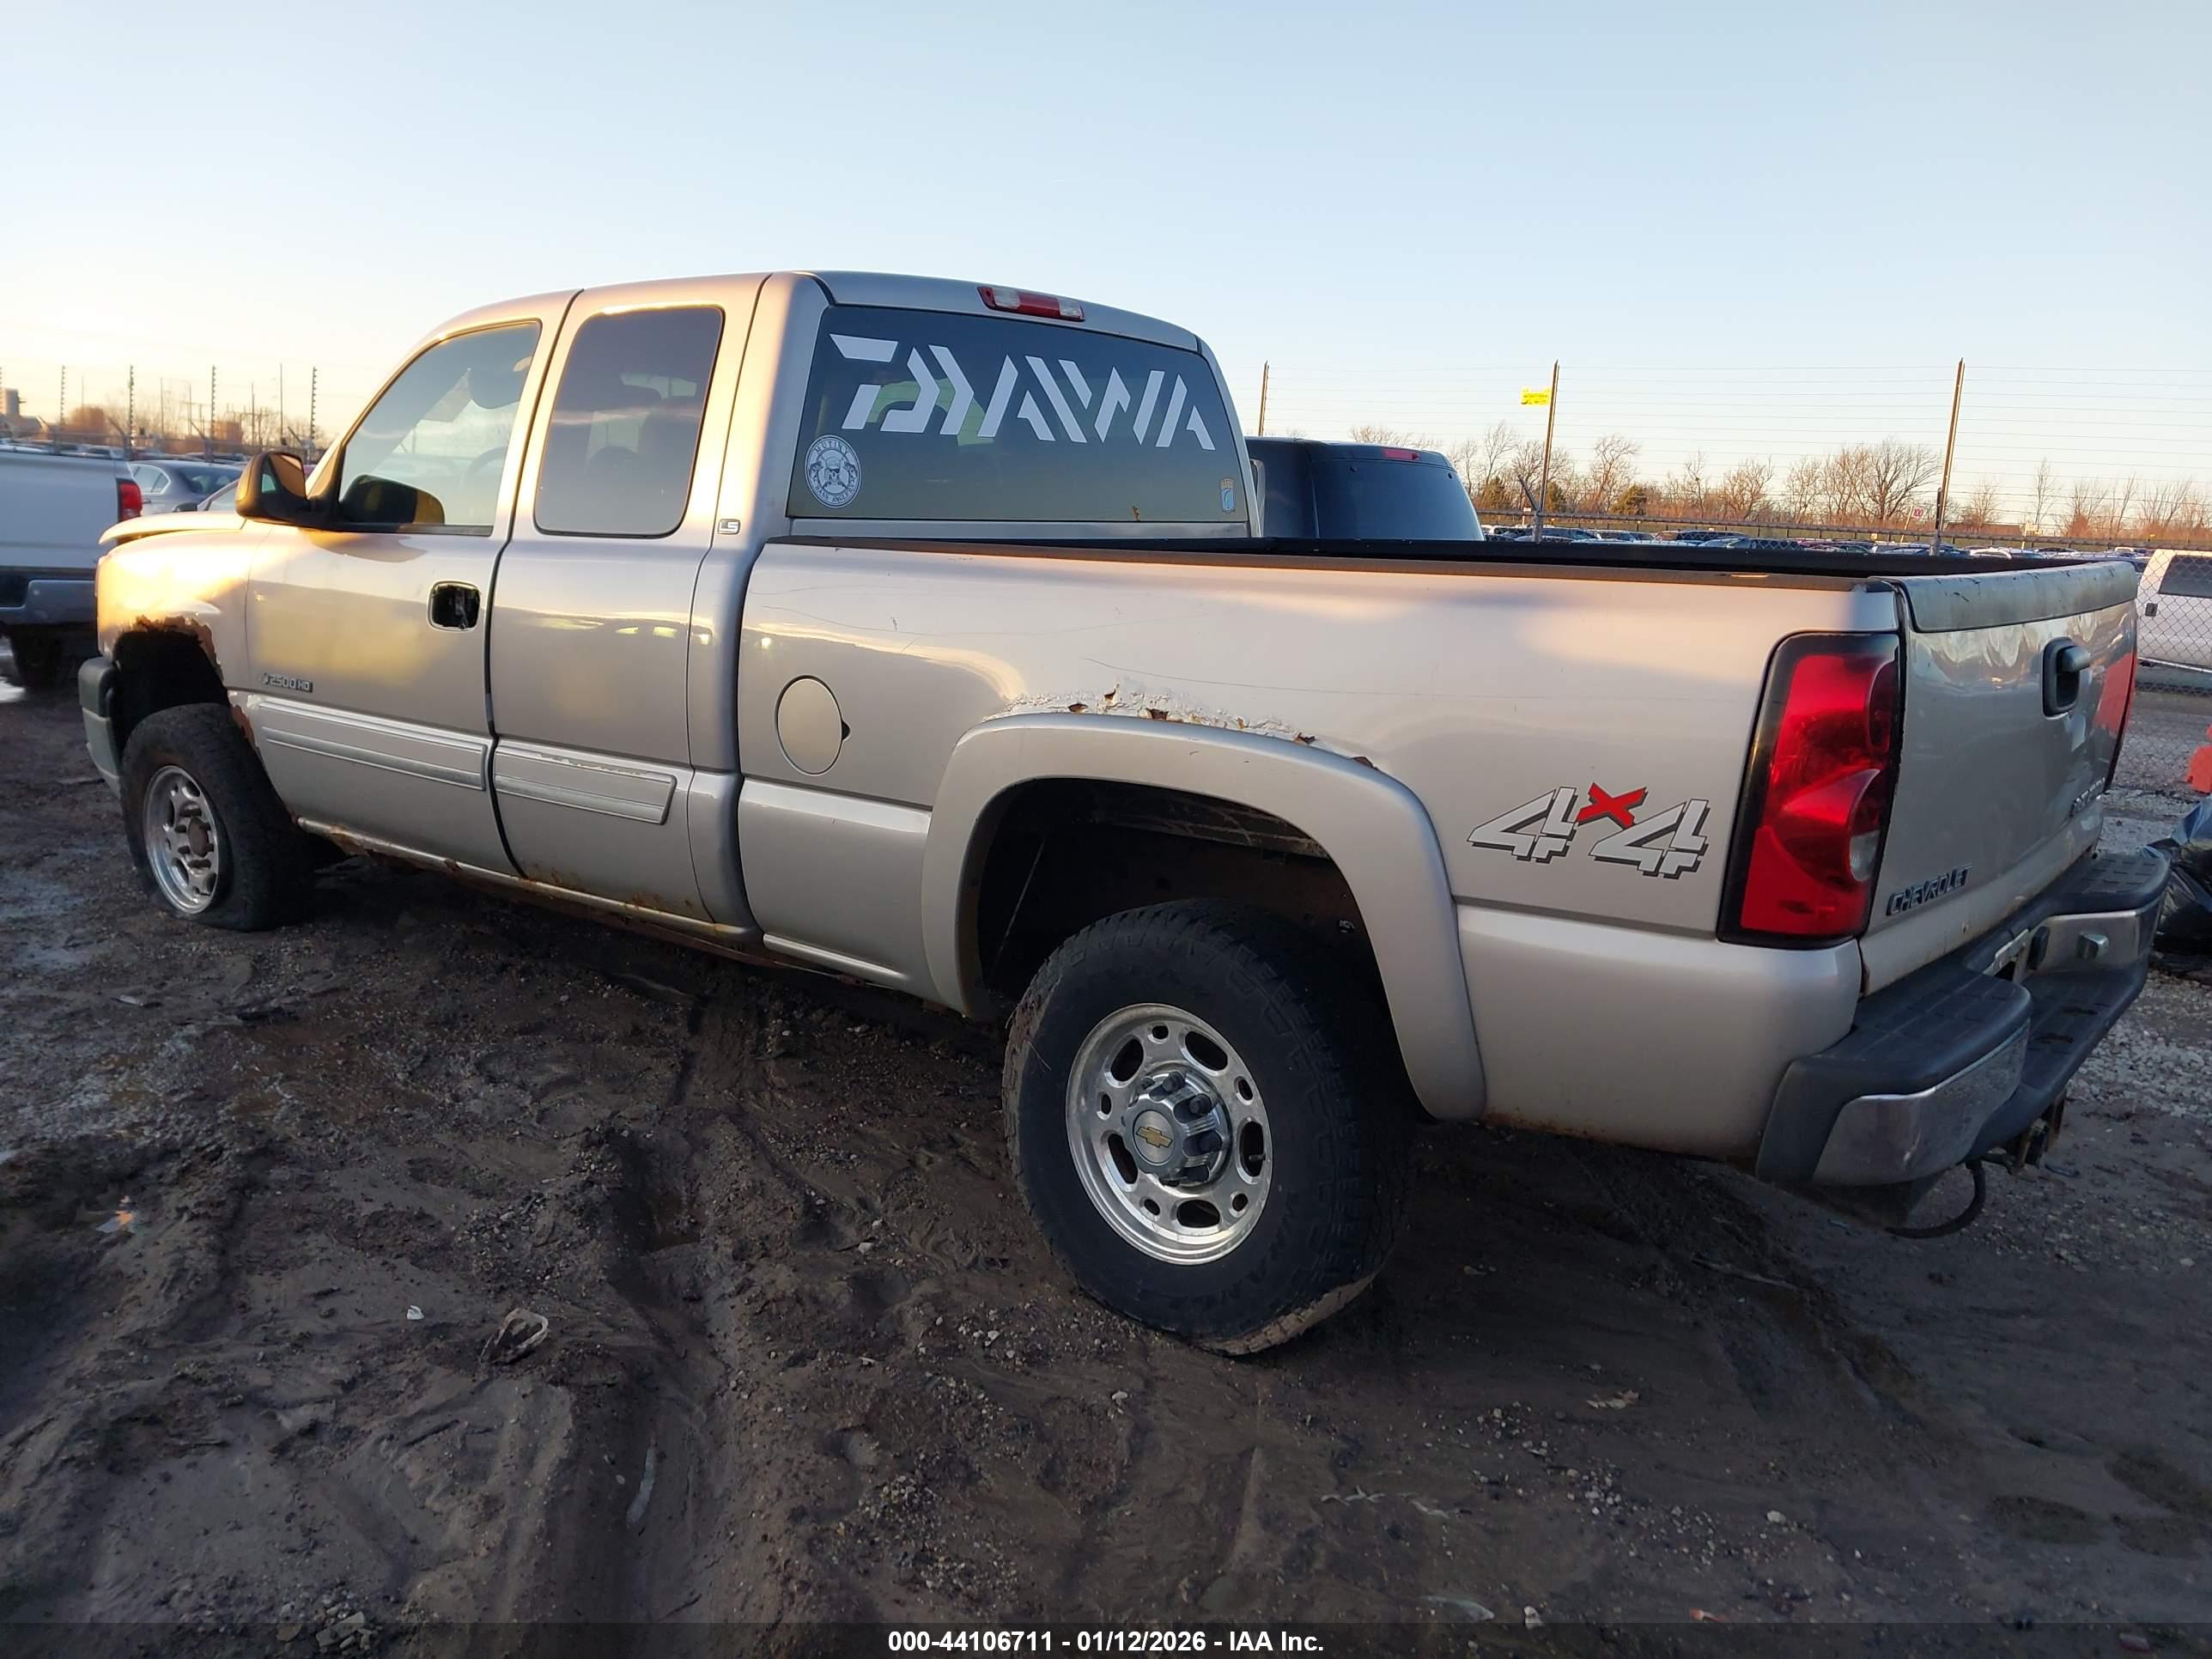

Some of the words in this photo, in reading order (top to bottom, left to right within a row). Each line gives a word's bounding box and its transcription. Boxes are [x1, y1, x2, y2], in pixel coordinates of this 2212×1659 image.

[815, 441, 848, 454] MUTINY
[720, 521, 738, 532] LS
[1887, 864, 1972, 916] CHEVROLET
